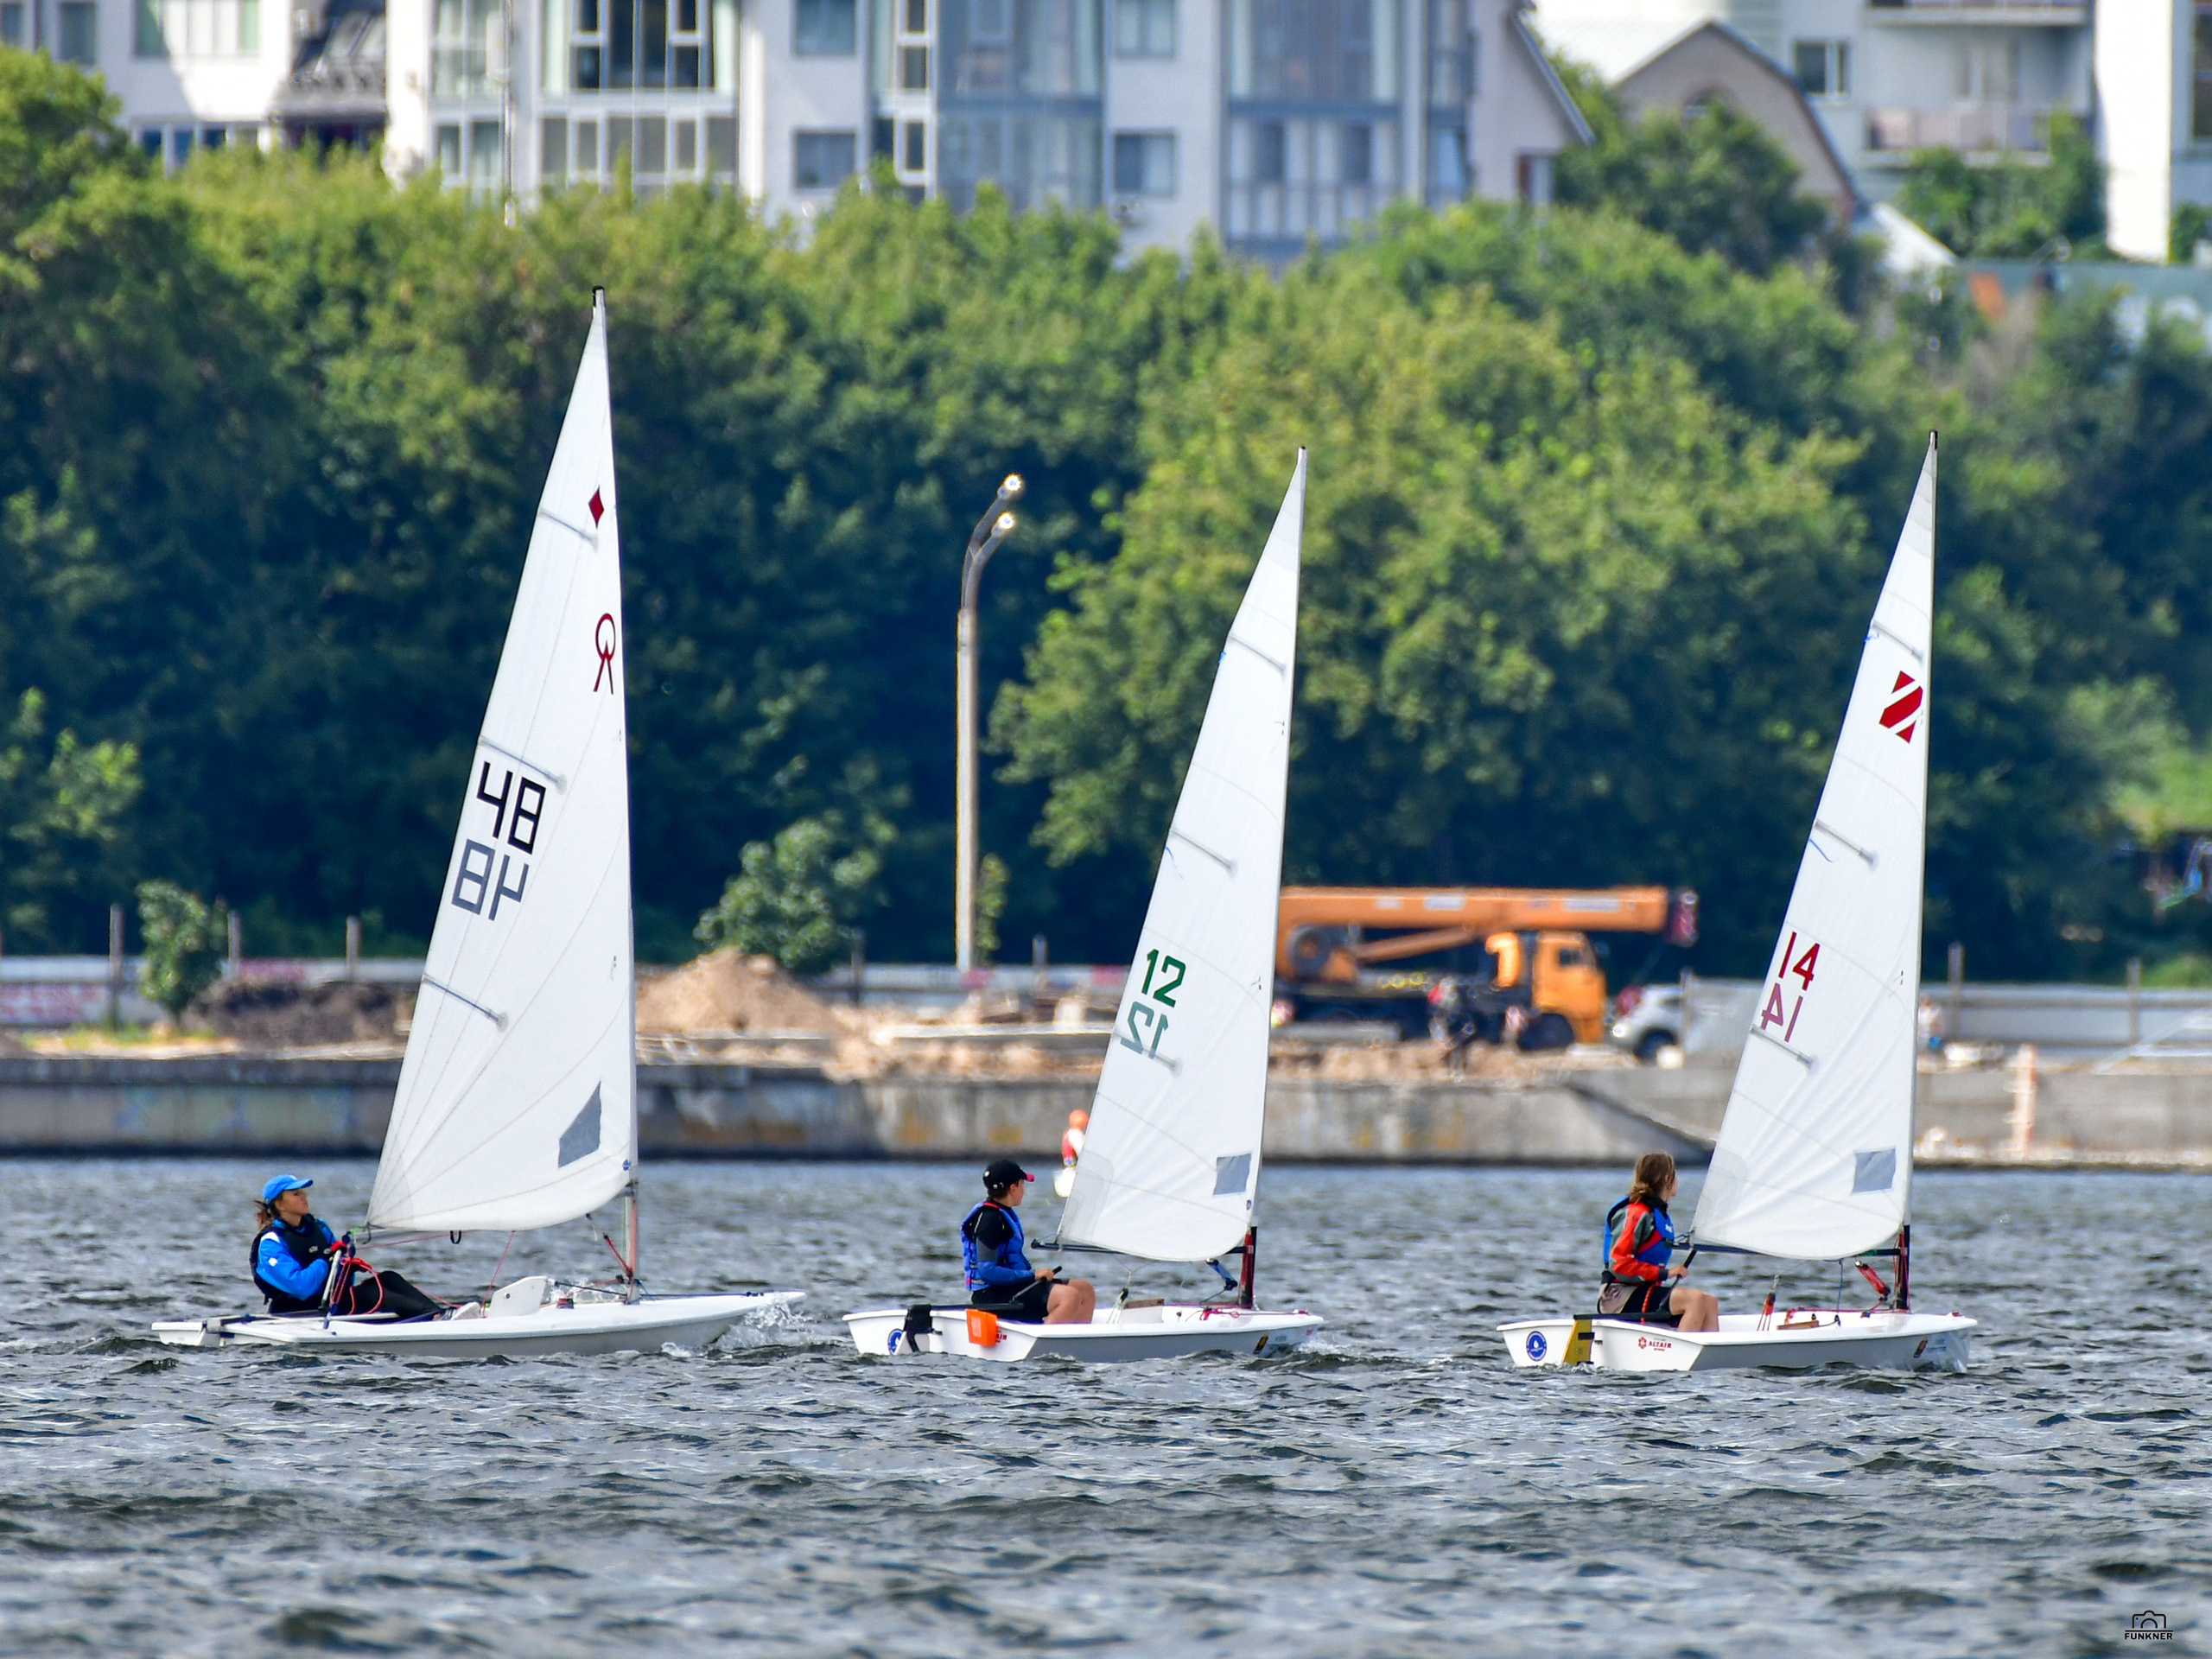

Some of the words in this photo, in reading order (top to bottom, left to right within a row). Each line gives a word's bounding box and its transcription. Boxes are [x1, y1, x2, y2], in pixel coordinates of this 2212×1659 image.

[476, 760, 547, 855] 48
[1141, 948, 1186, 1008] 12
[1778, 931, 1821, 992] 14
